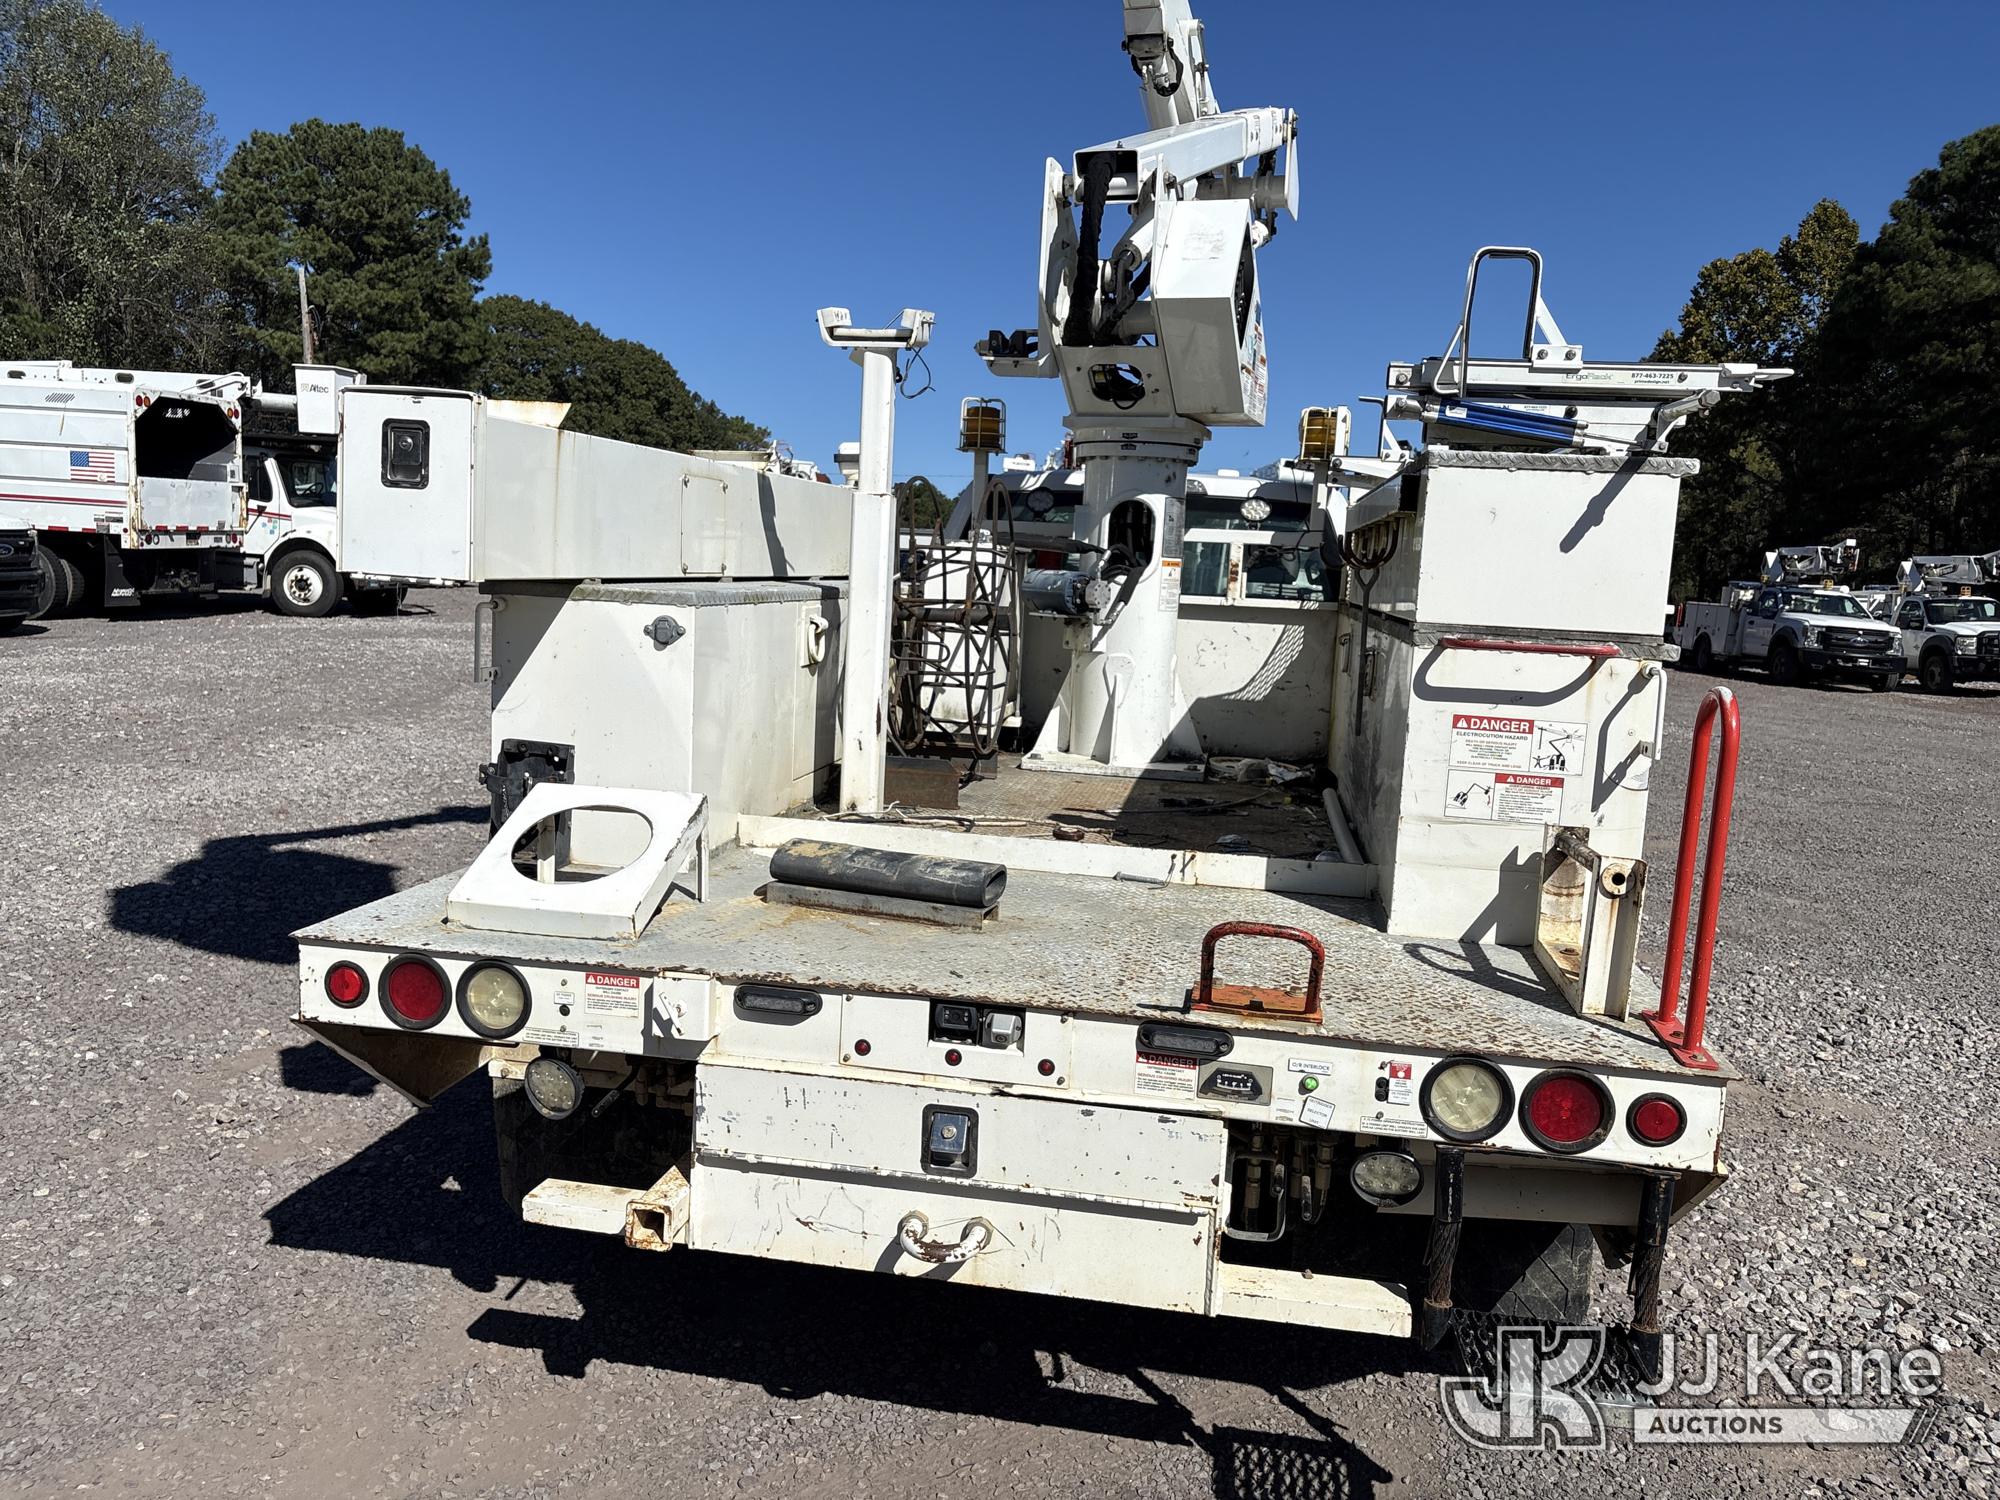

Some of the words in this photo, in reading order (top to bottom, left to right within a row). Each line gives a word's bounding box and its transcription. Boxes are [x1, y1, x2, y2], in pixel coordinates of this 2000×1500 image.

[310, 383, 329, 394] Altec
[1470, 718, 1530, 733] DANGER
[1456, 731, 1504, 739] ELECTROCUTION
[1516, 776, 1552, 786] DANGER
[597, 975, 637, 987] DANGER
[1149, 1055, 1194, 1068] DANGER
[1303, 1063, 1330, 1071] INTERLOCK
